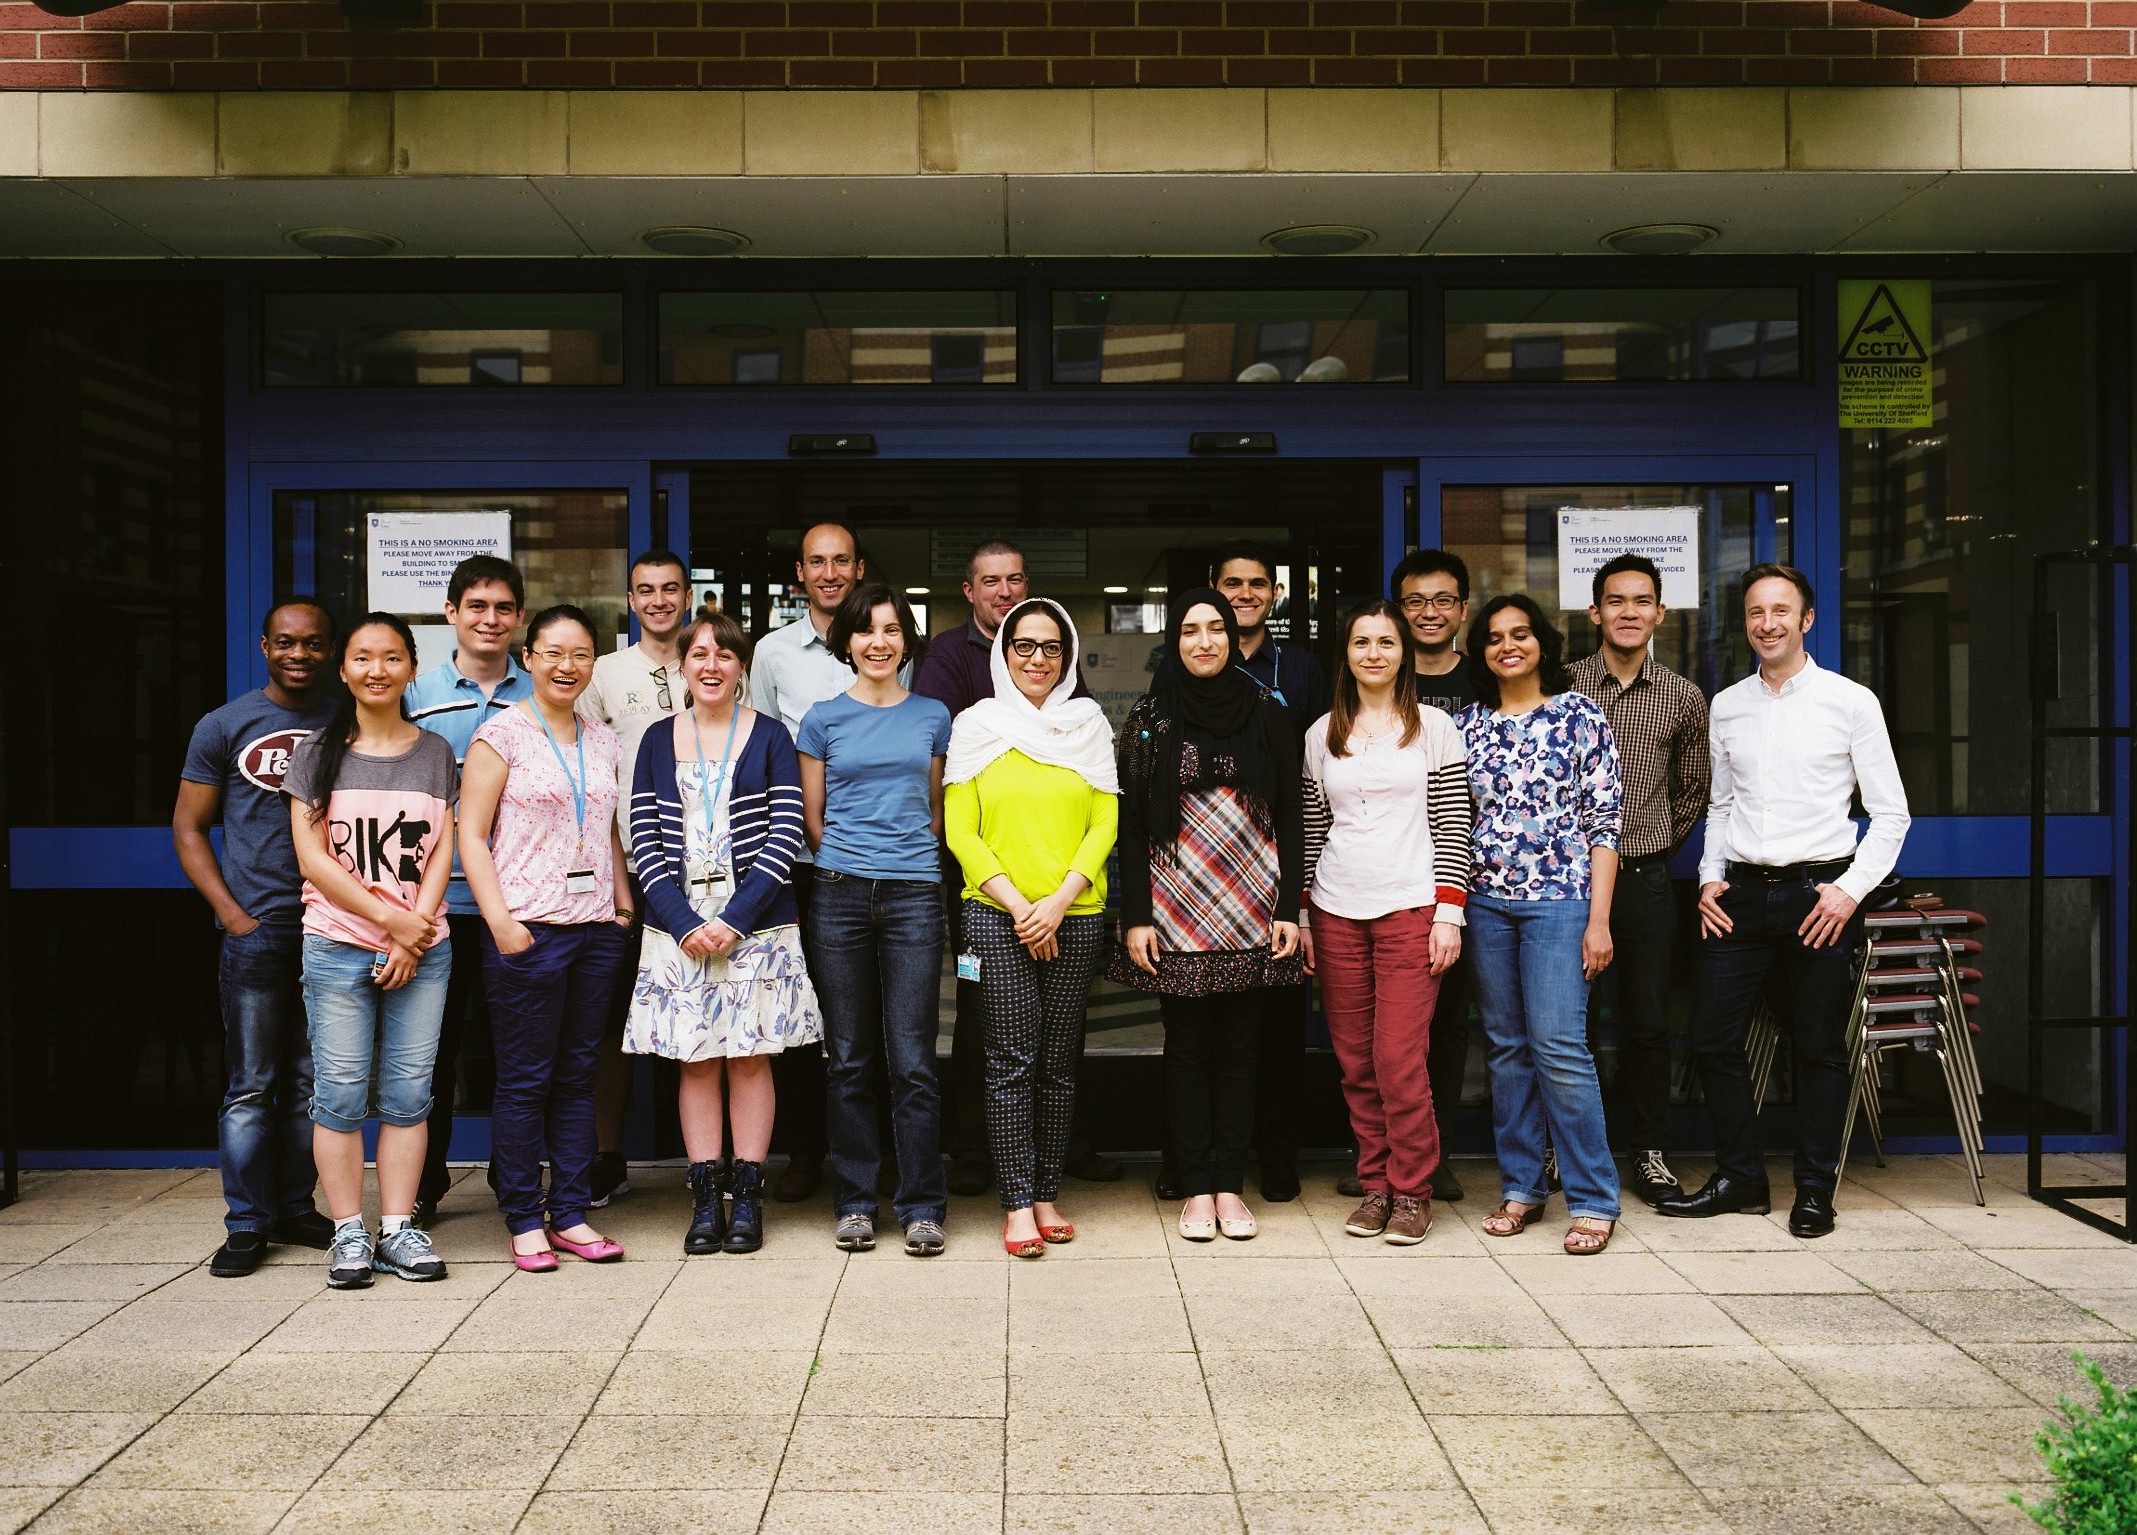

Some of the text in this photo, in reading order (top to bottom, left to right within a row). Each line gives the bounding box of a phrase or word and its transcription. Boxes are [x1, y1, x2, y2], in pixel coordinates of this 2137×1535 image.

[1856, 342, 1909, 356] CCTV
[1844, 366, 1922, 378] WARNING
[1877, 379, 1896, 387] being
[1922, 403, 1931, 411] by
[1853, 410, 1887, 418] University
[379, 539, 399, 547] THIS
[400, 539, 409, 547] IS
[418, 539, 431, 547] NO
[1570, 536, 1589, 544] THIS
[1591, 536, 1599, 544] IS
[626, 692, 639, 704] R
[252, 748, 291, 776] Pe
[329, 811, 432, 889] BIKE
